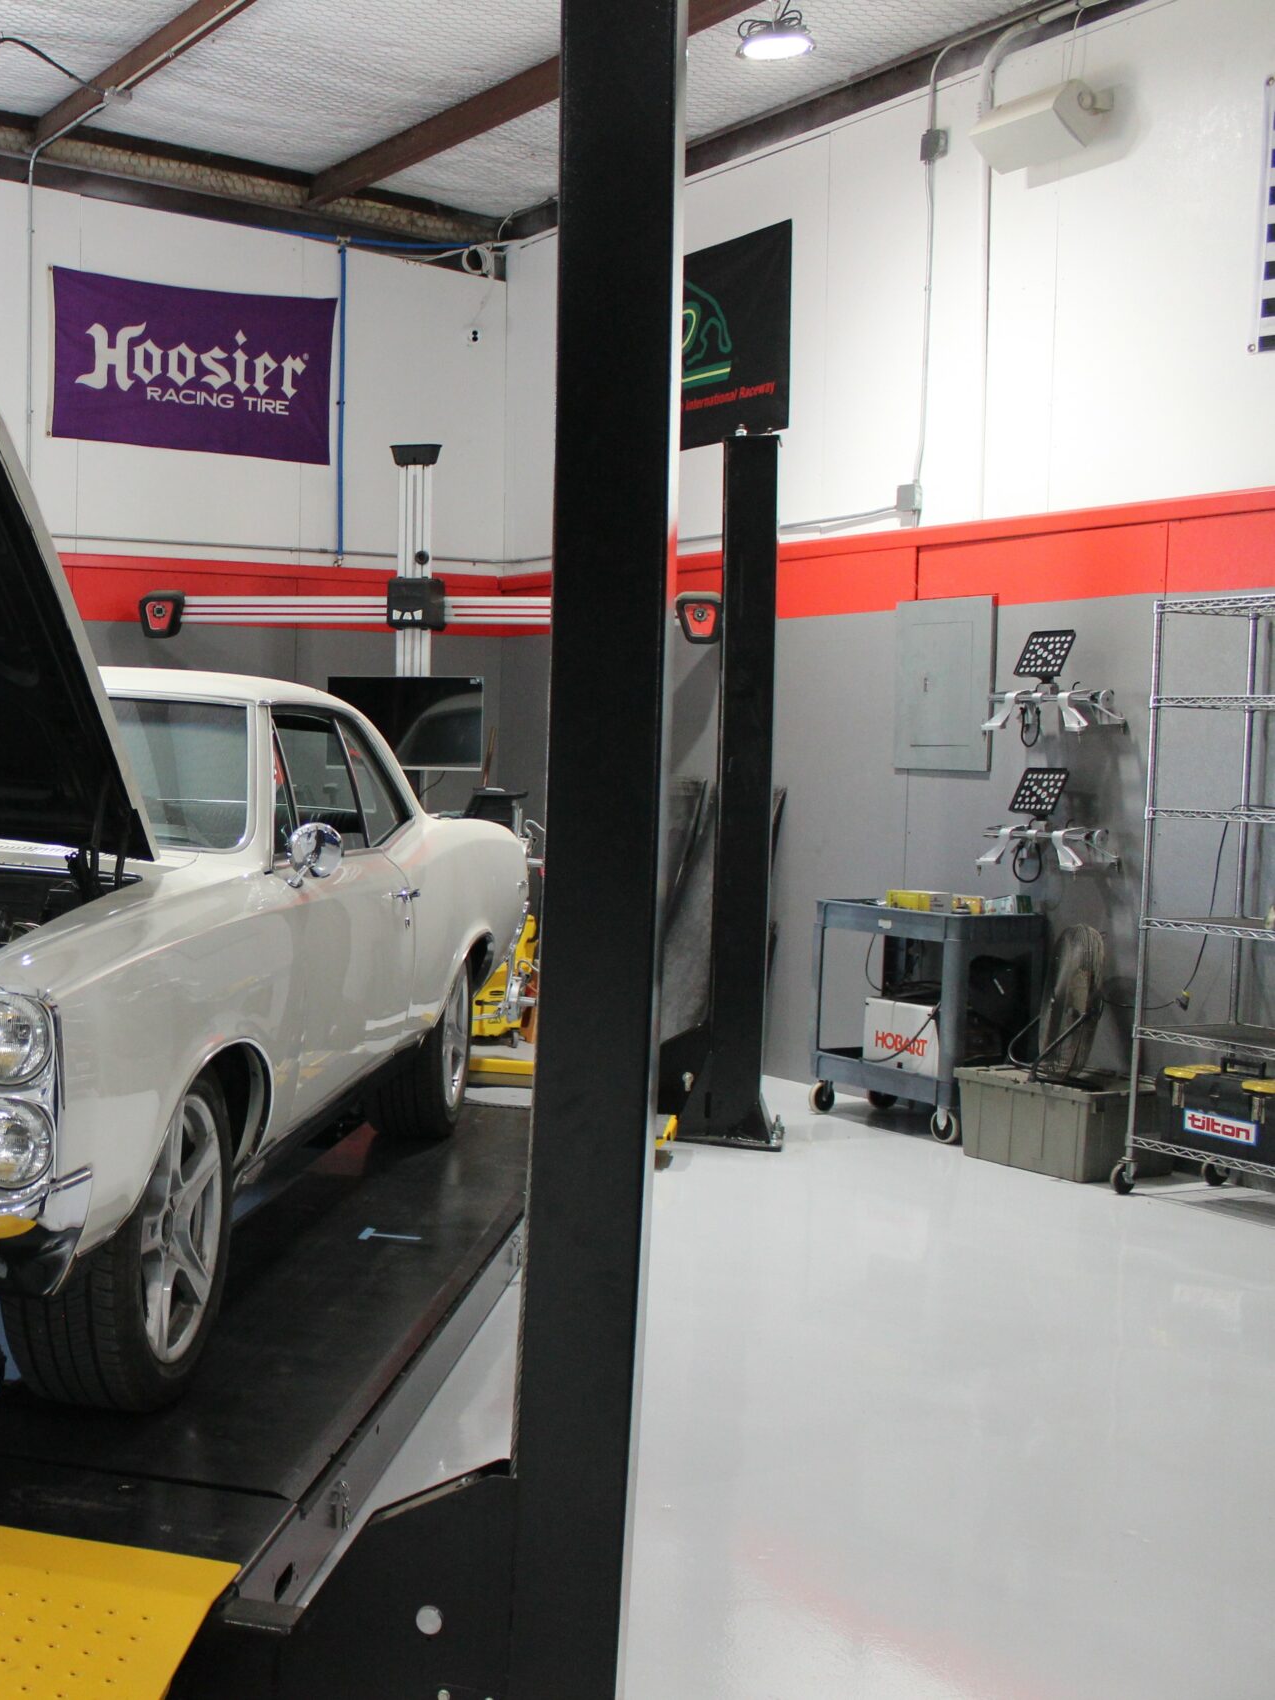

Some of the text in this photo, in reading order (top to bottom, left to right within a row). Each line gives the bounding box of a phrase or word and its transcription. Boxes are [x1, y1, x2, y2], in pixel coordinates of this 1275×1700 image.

[75, 321, 307, 399] Hoosier
[146, 386, 290, 416] RACING TIRE
[684, 381, 776, 411] International Raceway
[875, 1030, 928, 1057] HOBART
[1187, 1114, 1251, 1141] tilton
